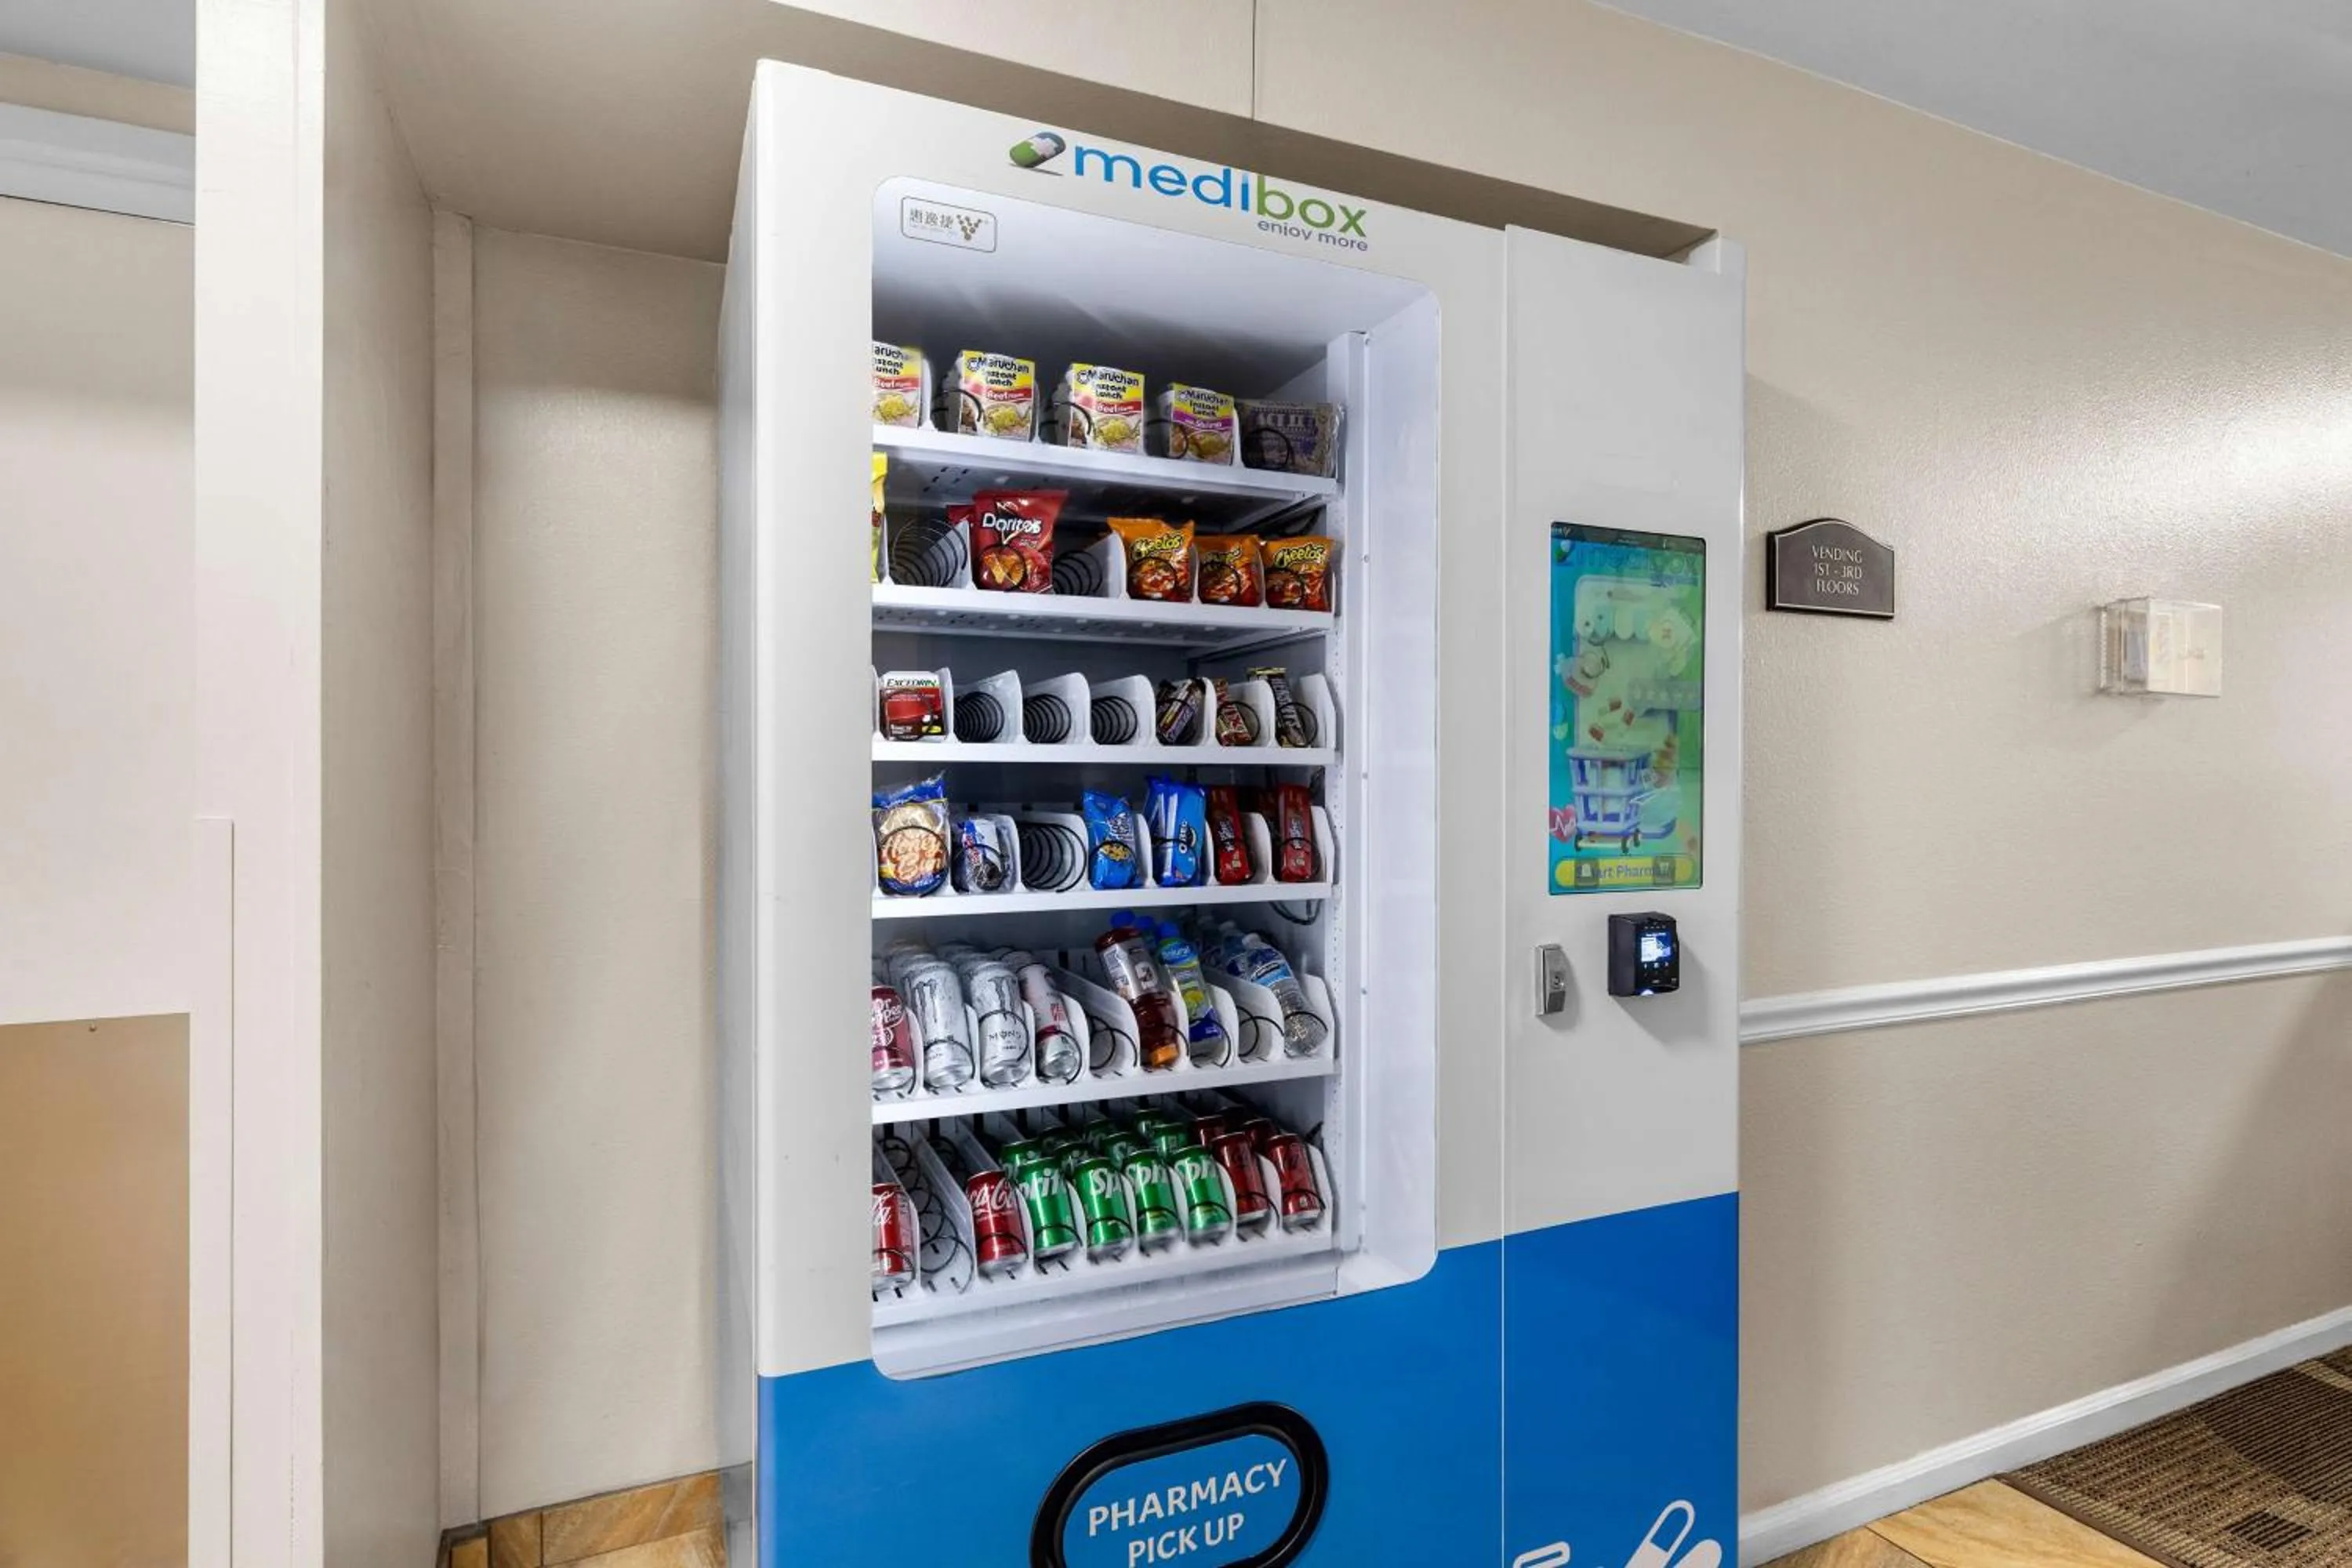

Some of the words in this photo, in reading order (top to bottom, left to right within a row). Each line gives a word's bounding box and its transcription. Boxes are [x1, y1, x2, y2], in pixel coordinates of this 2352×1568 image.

[1075, 145, 1367, 238] medibox
[1258, 219, 1312, 241] enjoy
[1318, 232, 1369, 252] more
[982, 512, 1042, 534] Doritos
[1274, 544, 1324, 568] Cheetos
[1812, 545, 1863, 564] VENDING
[1817, 579, 1859, 595] FLOORS
[1088, 1458, 1288, 1537] PHARMACY
[1128, 1525, 1198, 1568] PICK
[1204, 1512, 1245, 1546] UP
